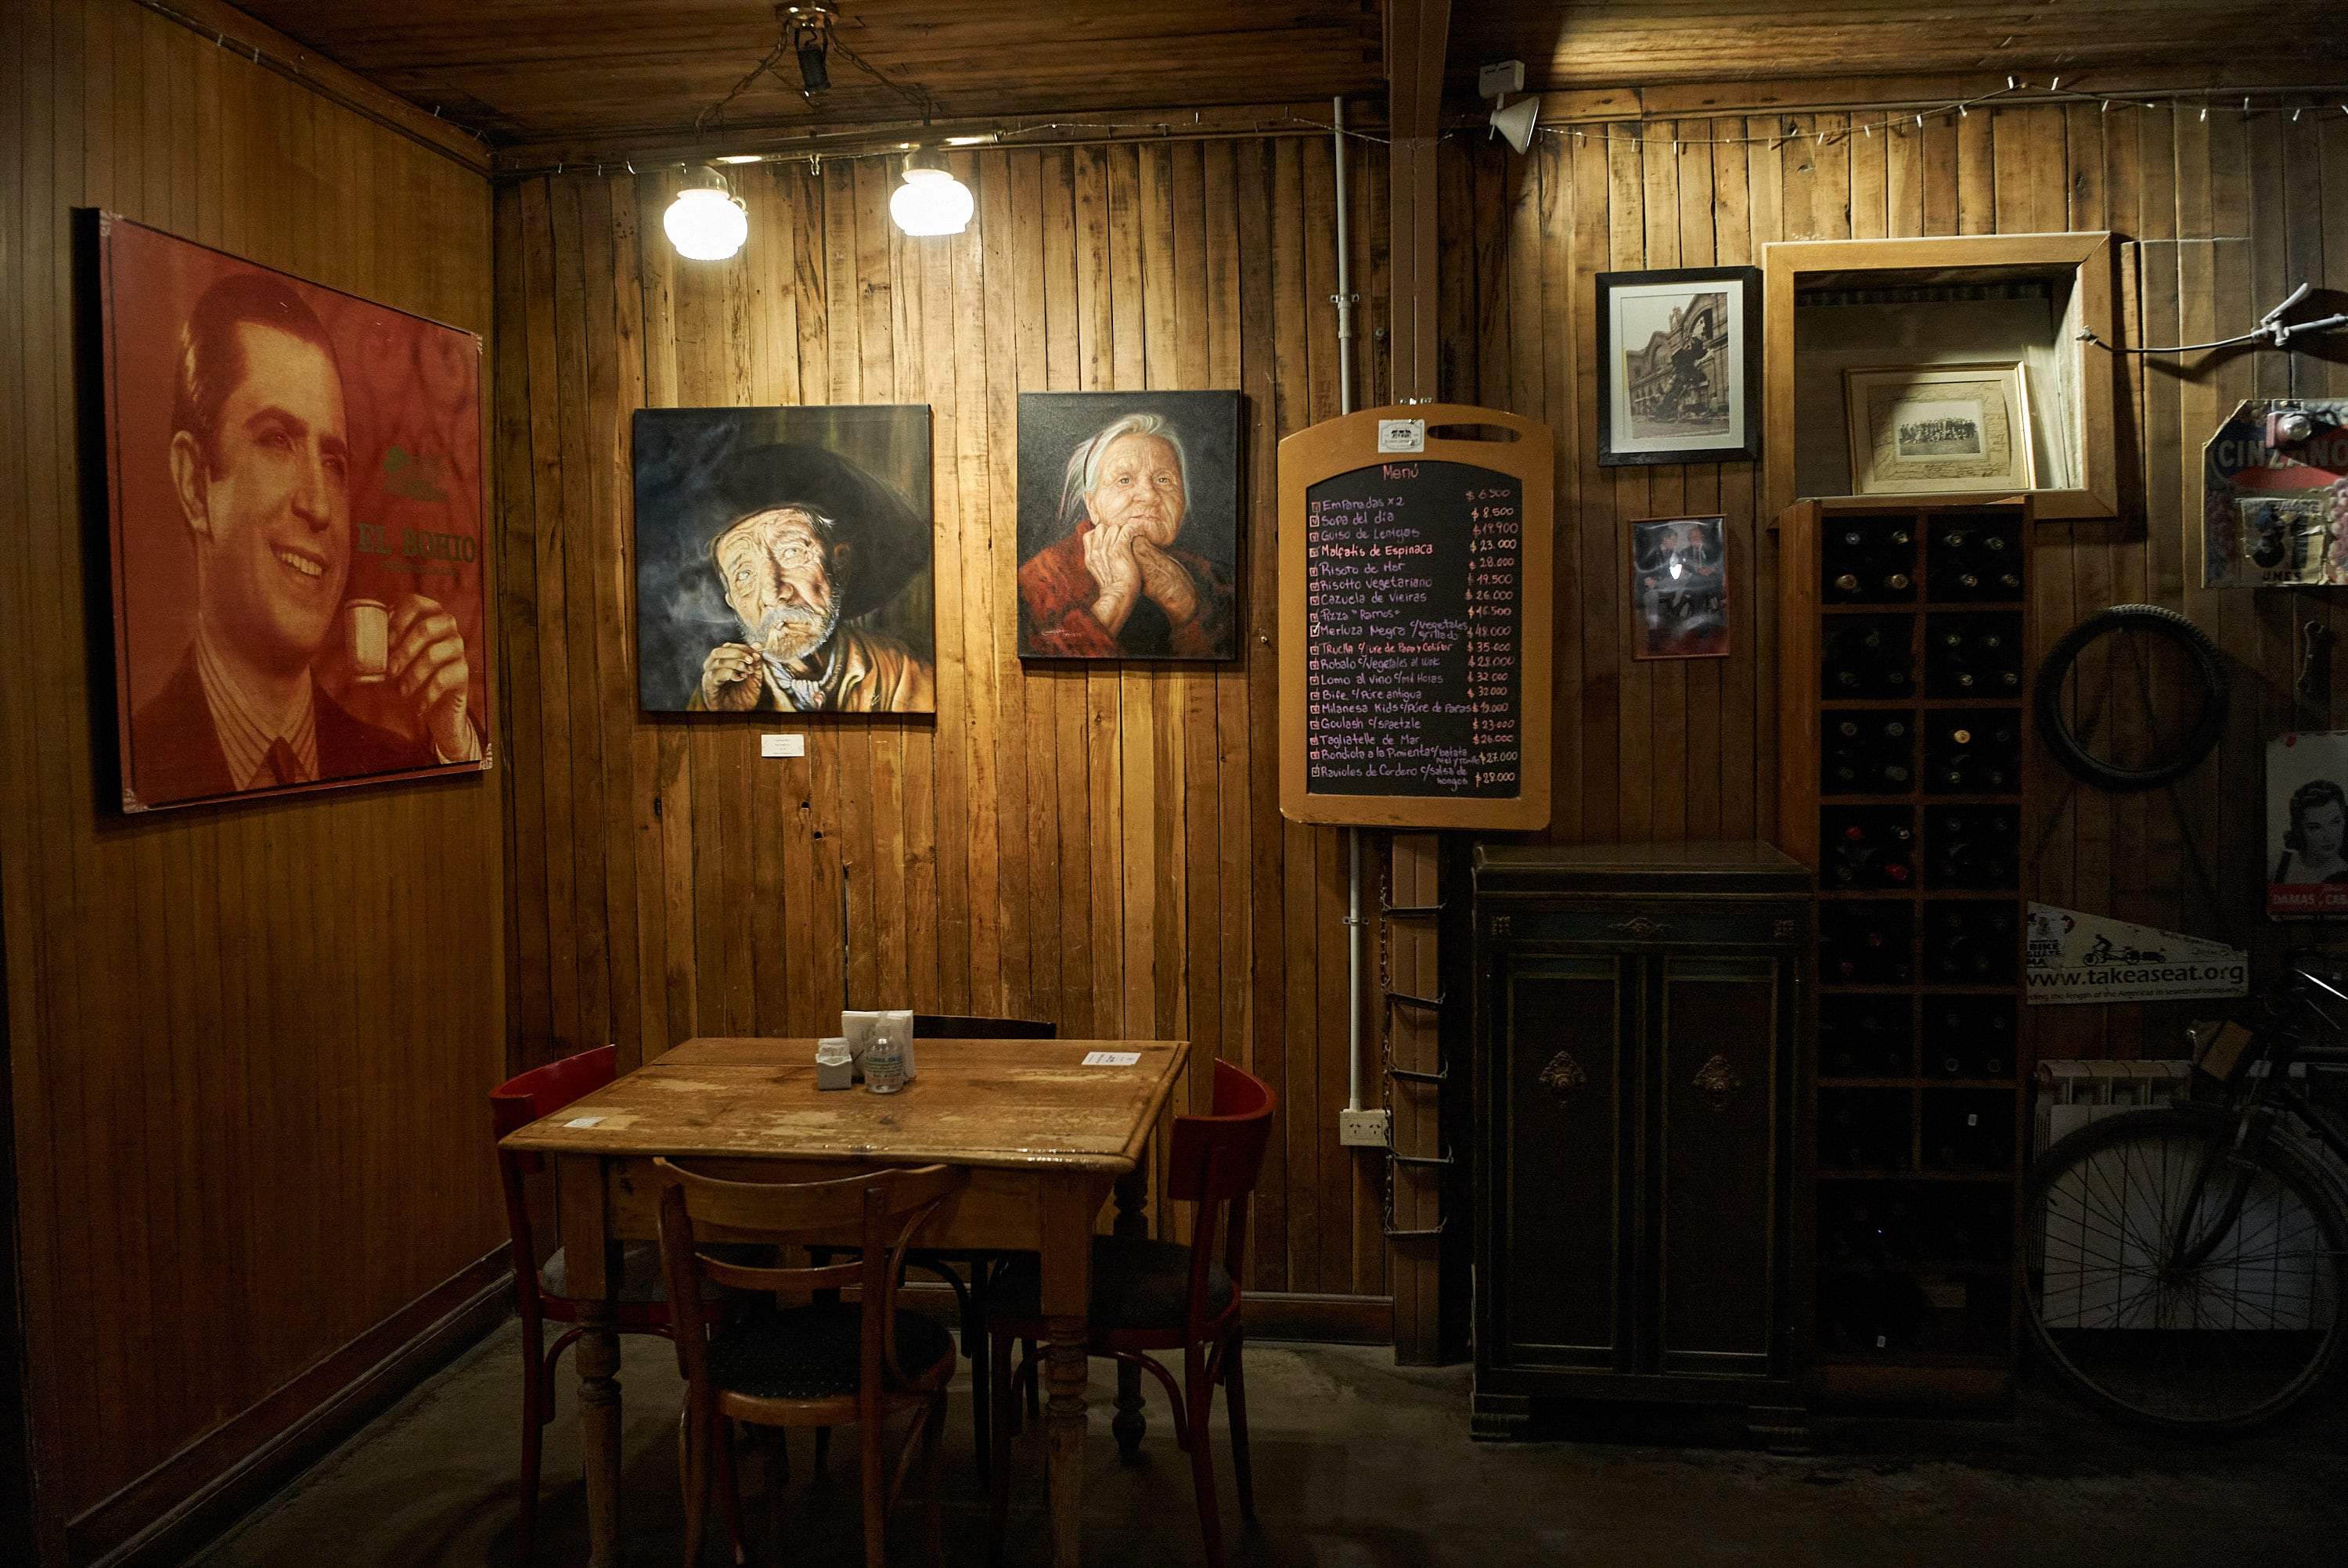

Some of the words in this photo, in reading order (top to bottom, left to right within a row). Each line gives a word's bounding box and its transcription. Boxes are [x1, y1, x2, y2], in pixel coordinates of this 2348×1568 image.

[1382, 463, 1419, 480] Menú
[1321, 515, 1348, 527] Sopa
[1352, 511, 1367, 525] del
[358, 521, 392, 556] EL
[1321, 530, 1350, 541] Guiso
[1356, 528, 1369, 540] de
[1370, 543, 1381, 557] de
[1364, 563, 1378, 574] de
[1320, 579, 1361, 590] Risotto
[1320, 592, 1365, 605] Cazuela
[1371, 591, 1384, 603] de
[1320, 624, 1363, 636] Merluza
[1385, 642, 1395, 653] de
[1320, 658, 1356, 670] Robalo
[1320, 674, 1350, 685] Lomo
[1356, 672, 1366, 684] al
[1322, 703, 1368, 714] Milanesa
[1374, 702, 1399, 714] Kids
[1432, 701, 1442, 713] de
[1321, 716, 1363, 729] Goulash
[1320, 732, 1376, 749] Tagliatelle
[1381, 734, 1393, 745] de
[1400, 734, 1420, 745] Mar
[1376, 746, 1385, 758] la
[1321, 764, 1362, 777] Ravioles
[1365, 764, 1377, 777] de
[1378, 763, 1417, 777] Cordero
